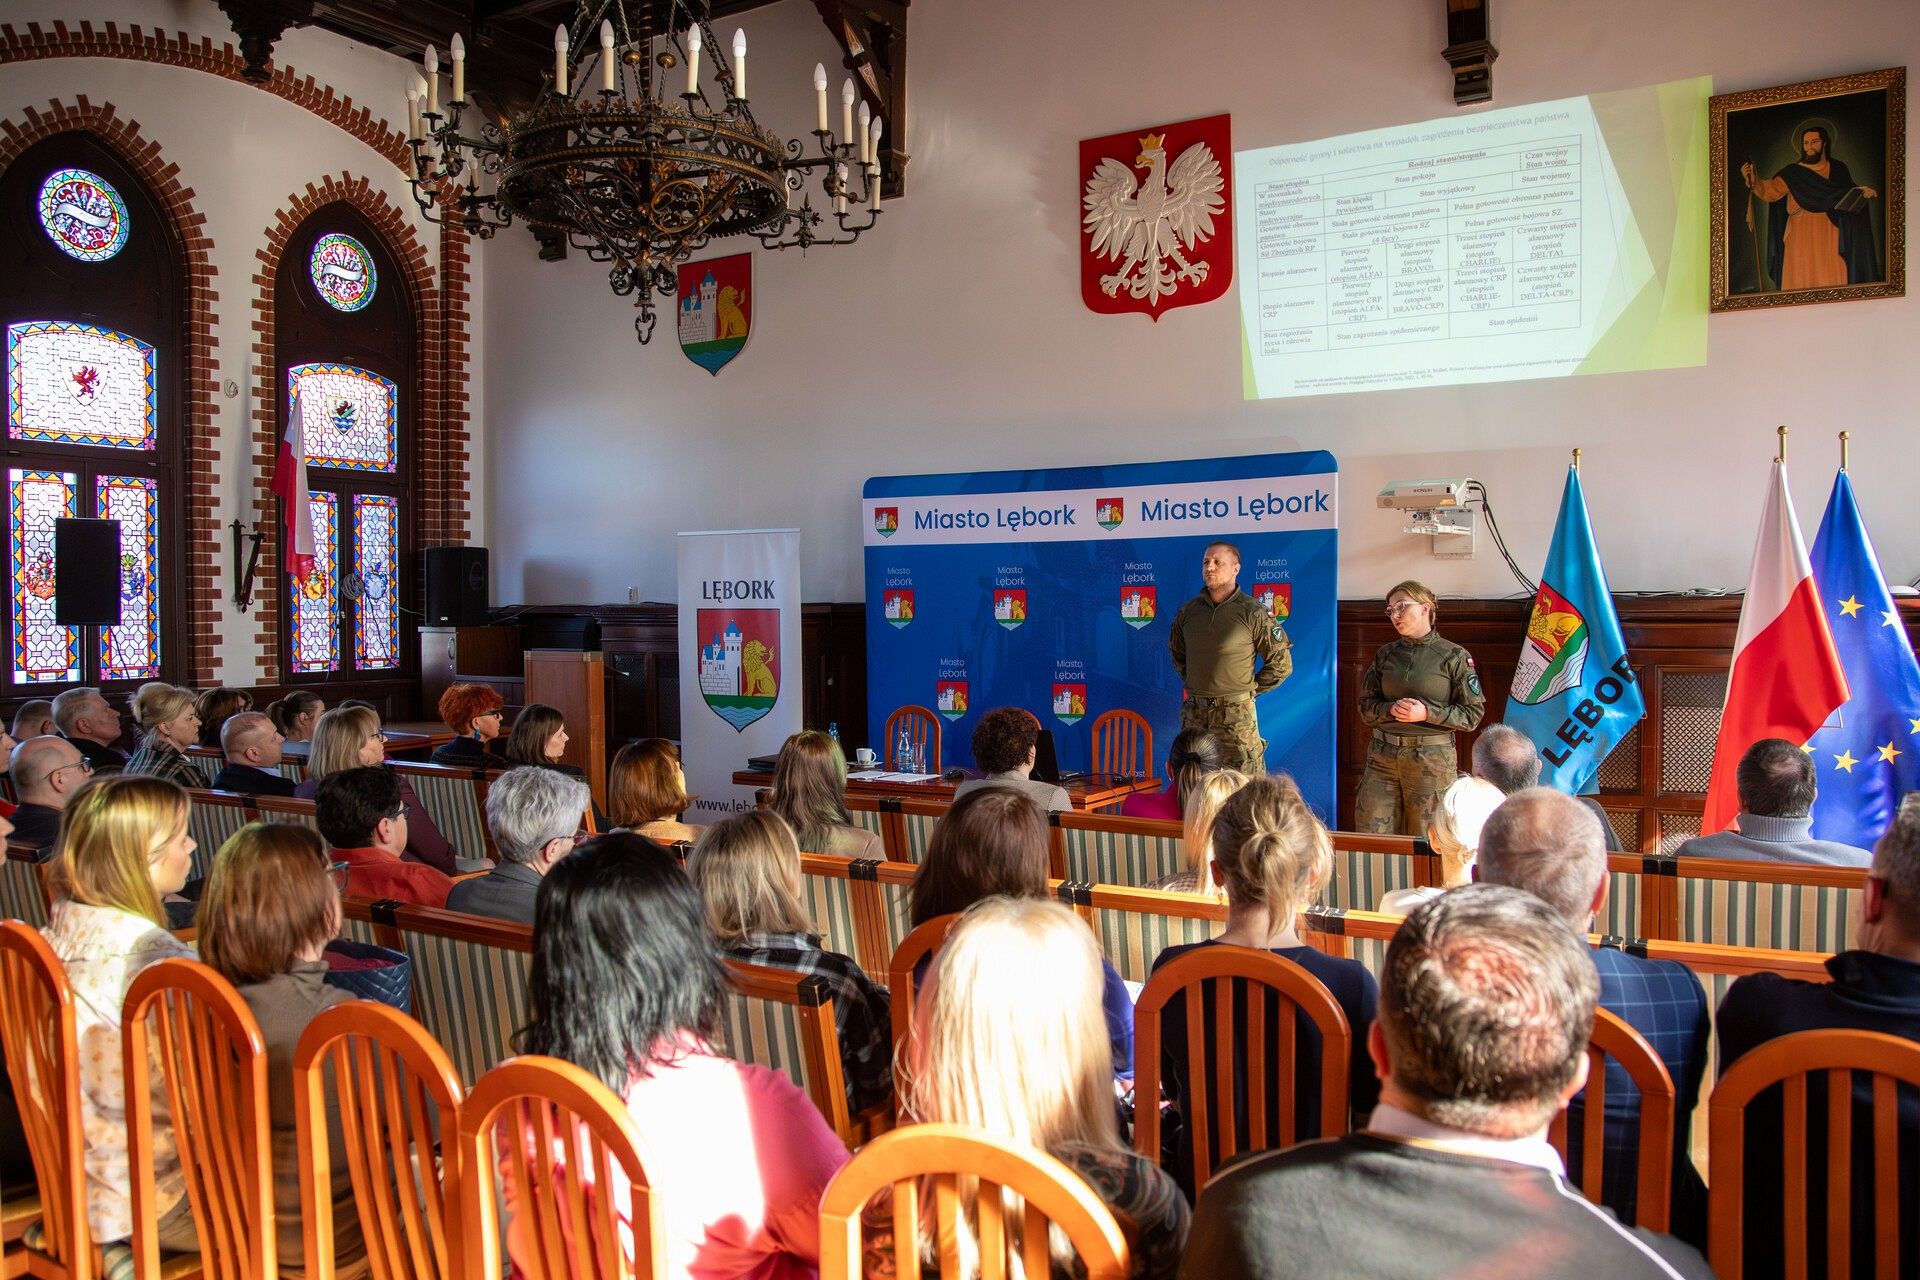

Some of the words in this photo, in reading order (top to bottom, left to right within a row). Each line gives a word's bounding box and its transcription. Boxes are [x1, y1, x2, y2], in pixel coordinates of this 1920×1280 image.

[1534, 112, 1569, 125] państwa
[1526, 160, 1544, 168] Stan
[1394, 175, 1411, 183] Stan
[1521, 175, 1539, 183] Stan
[1419, 189, 1435, 197] Stan
[1550, 222, 1577, 232] stopień
[1550, 262, 1577, 272] stopień
[1489, 318, 1505, 326] Stan
[1141, 498, 1229, 522] Miasto
[1237, 489, 1329, 521] Lębork
[914, 508, 989, 530] Miasto
[997, 504, 1076, 532] Lębork
[1124, 562, 1153, 570] Miasto
[1257, 558, 1287, 567] Miasto
[887, 567, 911, 575] Miasto
[997, 566, 1023, 574] Miasto
[1255, 569, 1290, 581] Lębork
[885, 577, 913, 587] Lębork
[995, 576, 1025, 587] Lębork
[1122, 572, 1155, 584] Lębork
[702, 580, 775, 603] LĘBORK
[940, 658, 965, 667] Miasto
[1056, 660, 1083, 668] Miasto
[939, 669, 967, 679] Lębork
[1054, 670, 1085, 682] Lębork
